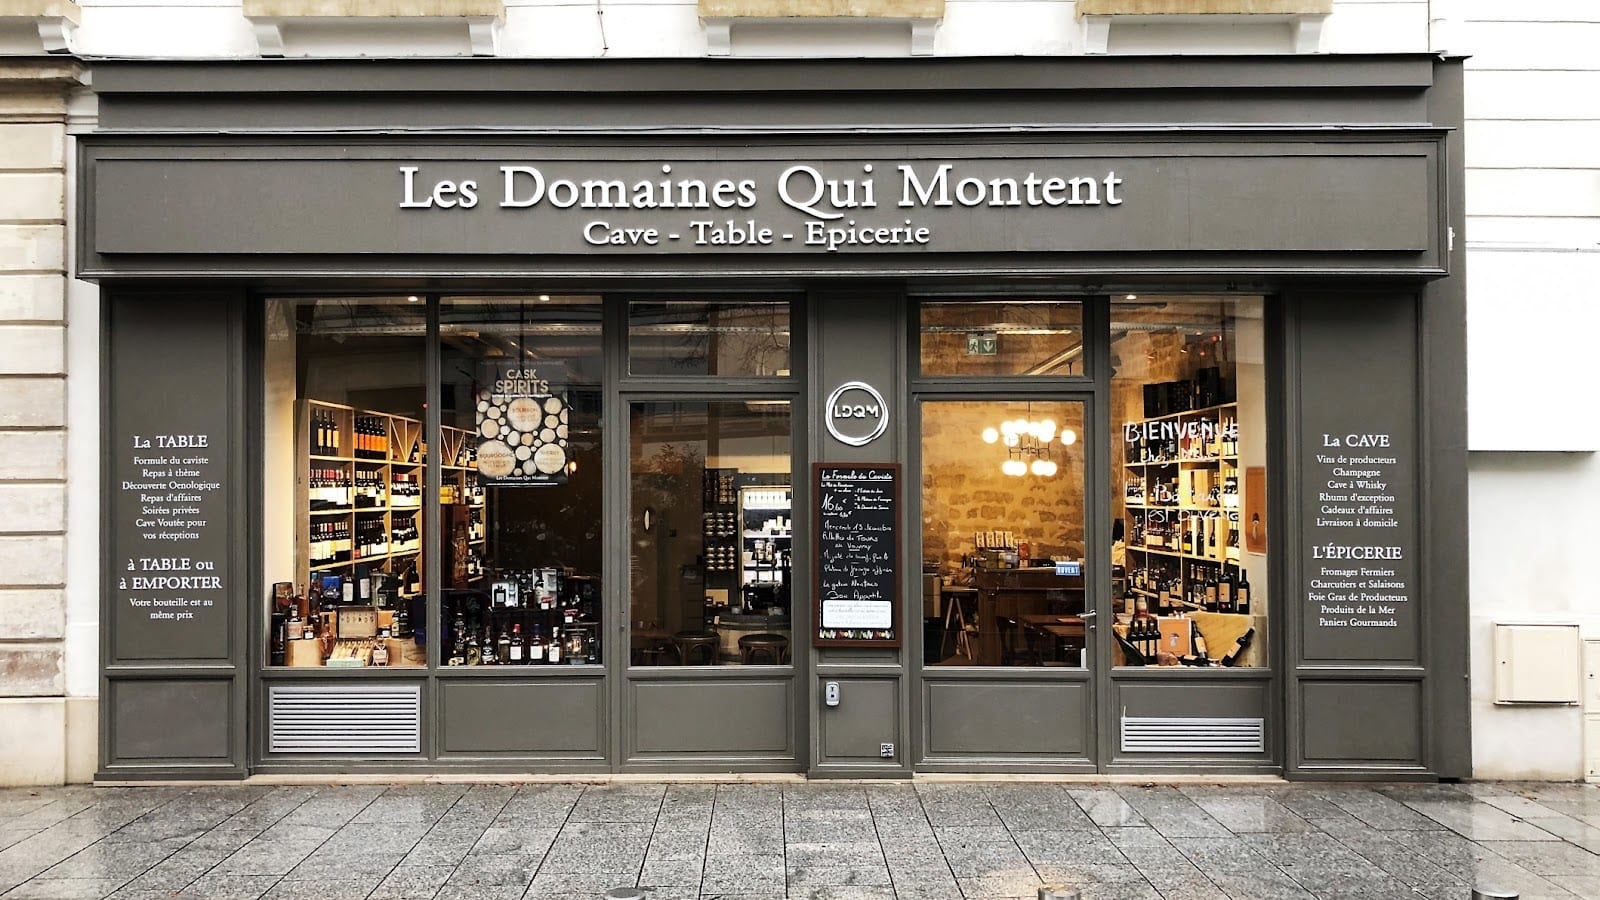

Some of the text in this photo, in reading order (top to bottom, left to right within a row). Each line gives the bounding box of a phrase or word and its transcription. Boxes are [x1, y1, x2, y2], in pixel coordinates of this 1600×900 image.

[399, 163, 1123, 219] Les Domaines Qui Montent
[583, 221, 659, 246] Cave
[690, 220, 773, 245] Table
[805, 219, 930, 252] Epicerie
[506, 369, 537, 379] CASK
[495, 380, 549, 394] SPIRITS
[834, 404, 879, 418] LDQM
[134, 435, 209, 448] La TABLE
[1323, 434, 1390, 448] La CAVE
[134, 456, 208, 465] Formule du caviste
[1317, 455, 1397, 465] Vins de producteurs
[142, 467, 200, 479] Repas à thème
[1333, 467, 1381, 478] Champagne
[122, 481, 220, 492] Découverte Oenologique
[1328, 480, 1387, 491] Cave à Whisky
[141, 493, 202, 503] Repas d'affaires
[1319, 493, 1395, 503] Rhums d'exception
[142, 505, 200, 516] Soirées privées
[1321, 505, 1394, 514] Cadeaux d'affaires
[136, 518, 207, 529] Cave Voutée pour
[1317, 518, 1398, 527] Livraison à domicile
[159, 530, 199, 541] réceptions
[1313, 542, 1402, 560] L'ÉPICERIE
[128, 558, 214, 571] à TABLE ou
[1321, 567, 1395, 577] Fromages Fermiers
[120, 576, 222, 590] à EMPORTER
[1310, 580, 1405, 589] Charcutiers et Salaisons
[130, 598, 151, 607] Votre
[154, 598, 188, 607] bouteille
[190, 599, 201, 607] est
[1308, 592, 1408, 602] Foie Gras de Producteurs
[150, 610, 193, 620] même prix
[1321, 605, 1396, 614] Produits de la Mer
[1319, 617, 1398, 627] Paniers Gourmands
